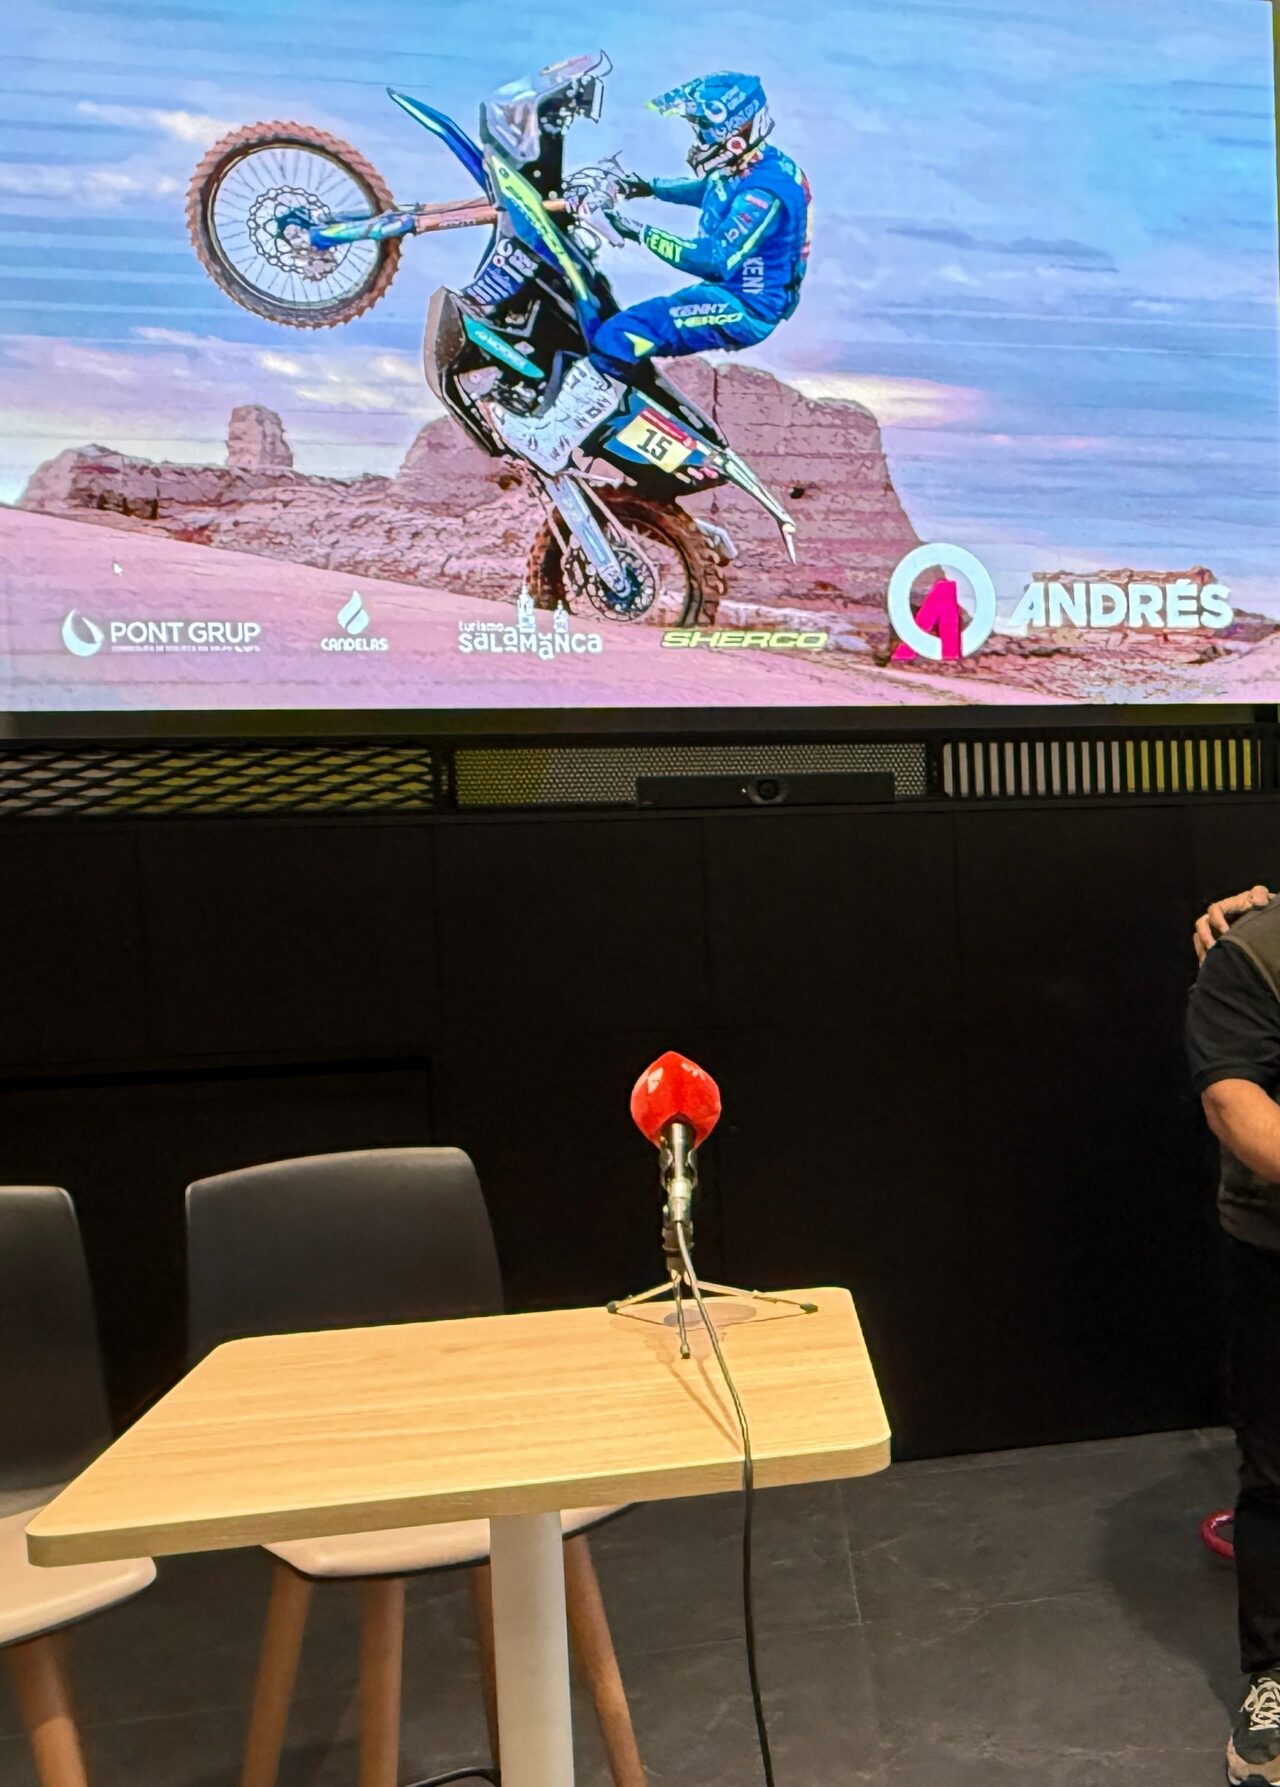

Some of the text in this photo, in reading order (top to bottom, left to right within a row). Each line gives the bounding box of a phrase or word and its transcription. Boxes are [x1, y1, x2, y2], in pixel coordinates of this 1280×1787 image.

[637, 428, 673, 462] 15
[110, 621, 261, 643] PONT GRUP
[660, 630, 828, 651] SHERCO
